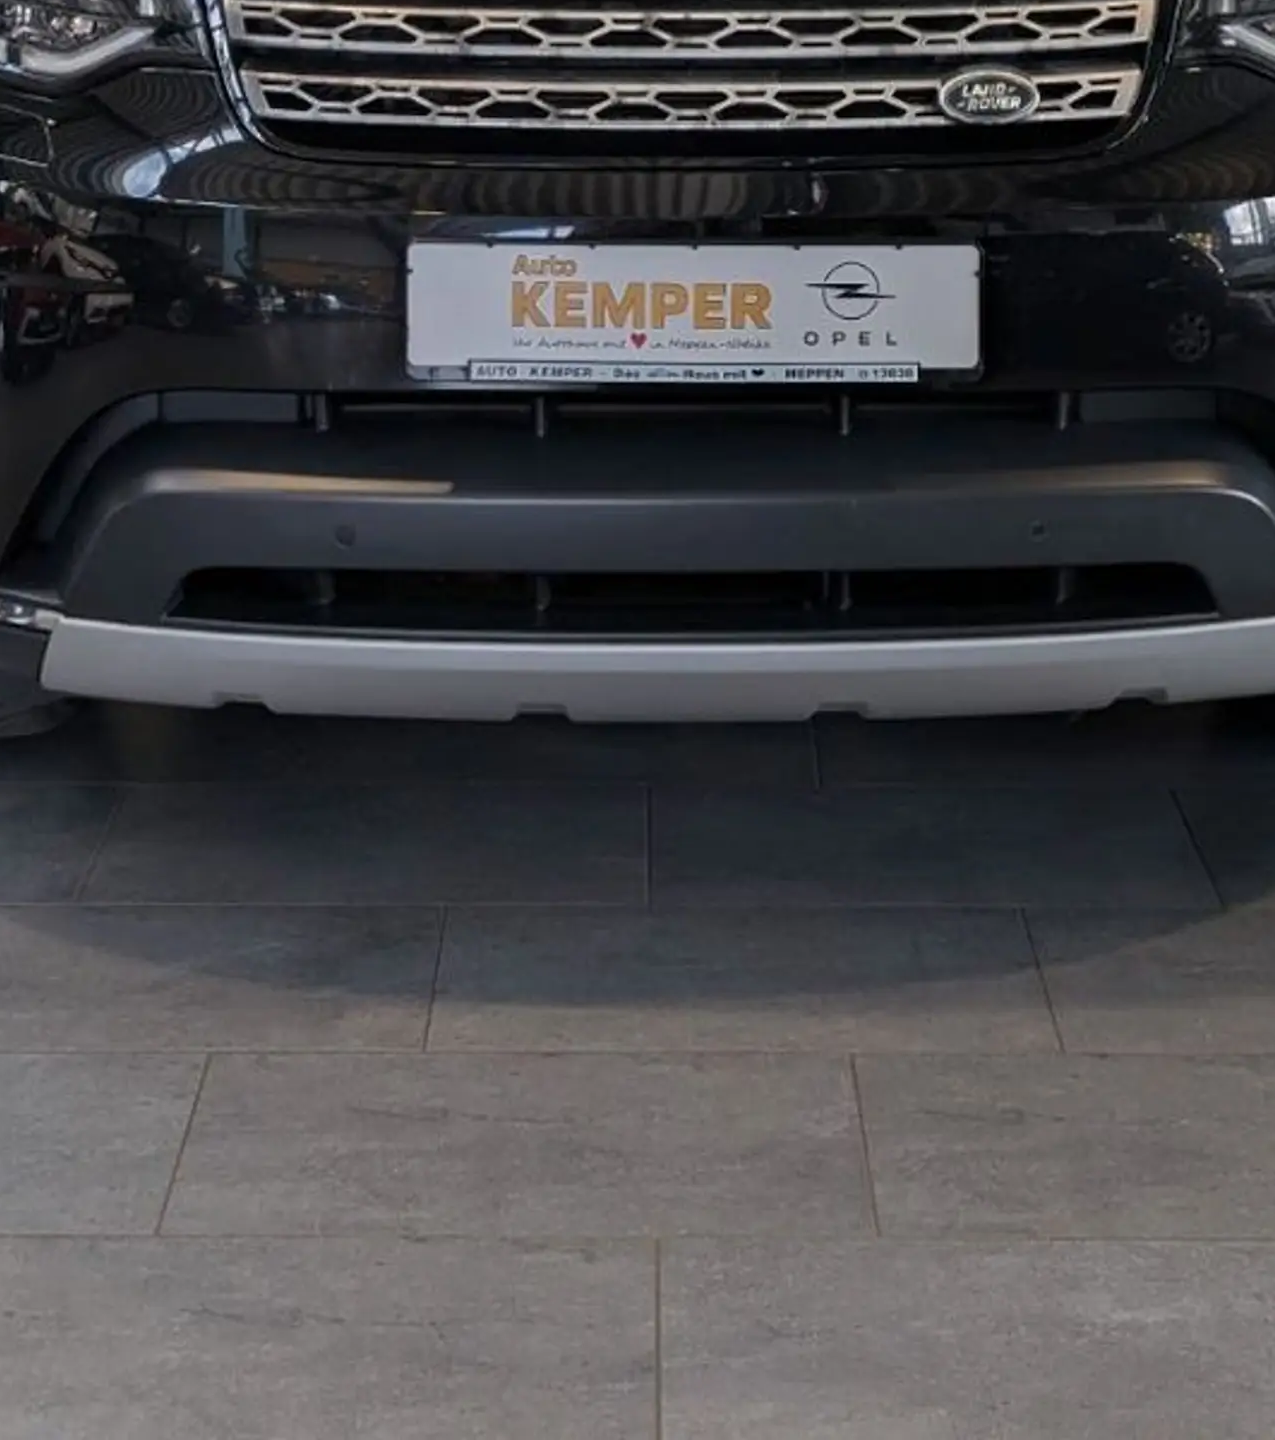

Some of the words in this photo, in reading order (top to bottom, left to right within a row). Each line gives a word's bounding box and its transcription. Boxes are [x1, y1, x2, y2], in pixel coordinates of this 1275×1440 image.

[968, 96, 1021, 111] ROVER
[512, 254, 577, 276] Auto
[512, 281, 772, 330] KEMPER
[804, 331, 898, 346] OPEL
[530, 366, 592, 377] KEMPER
